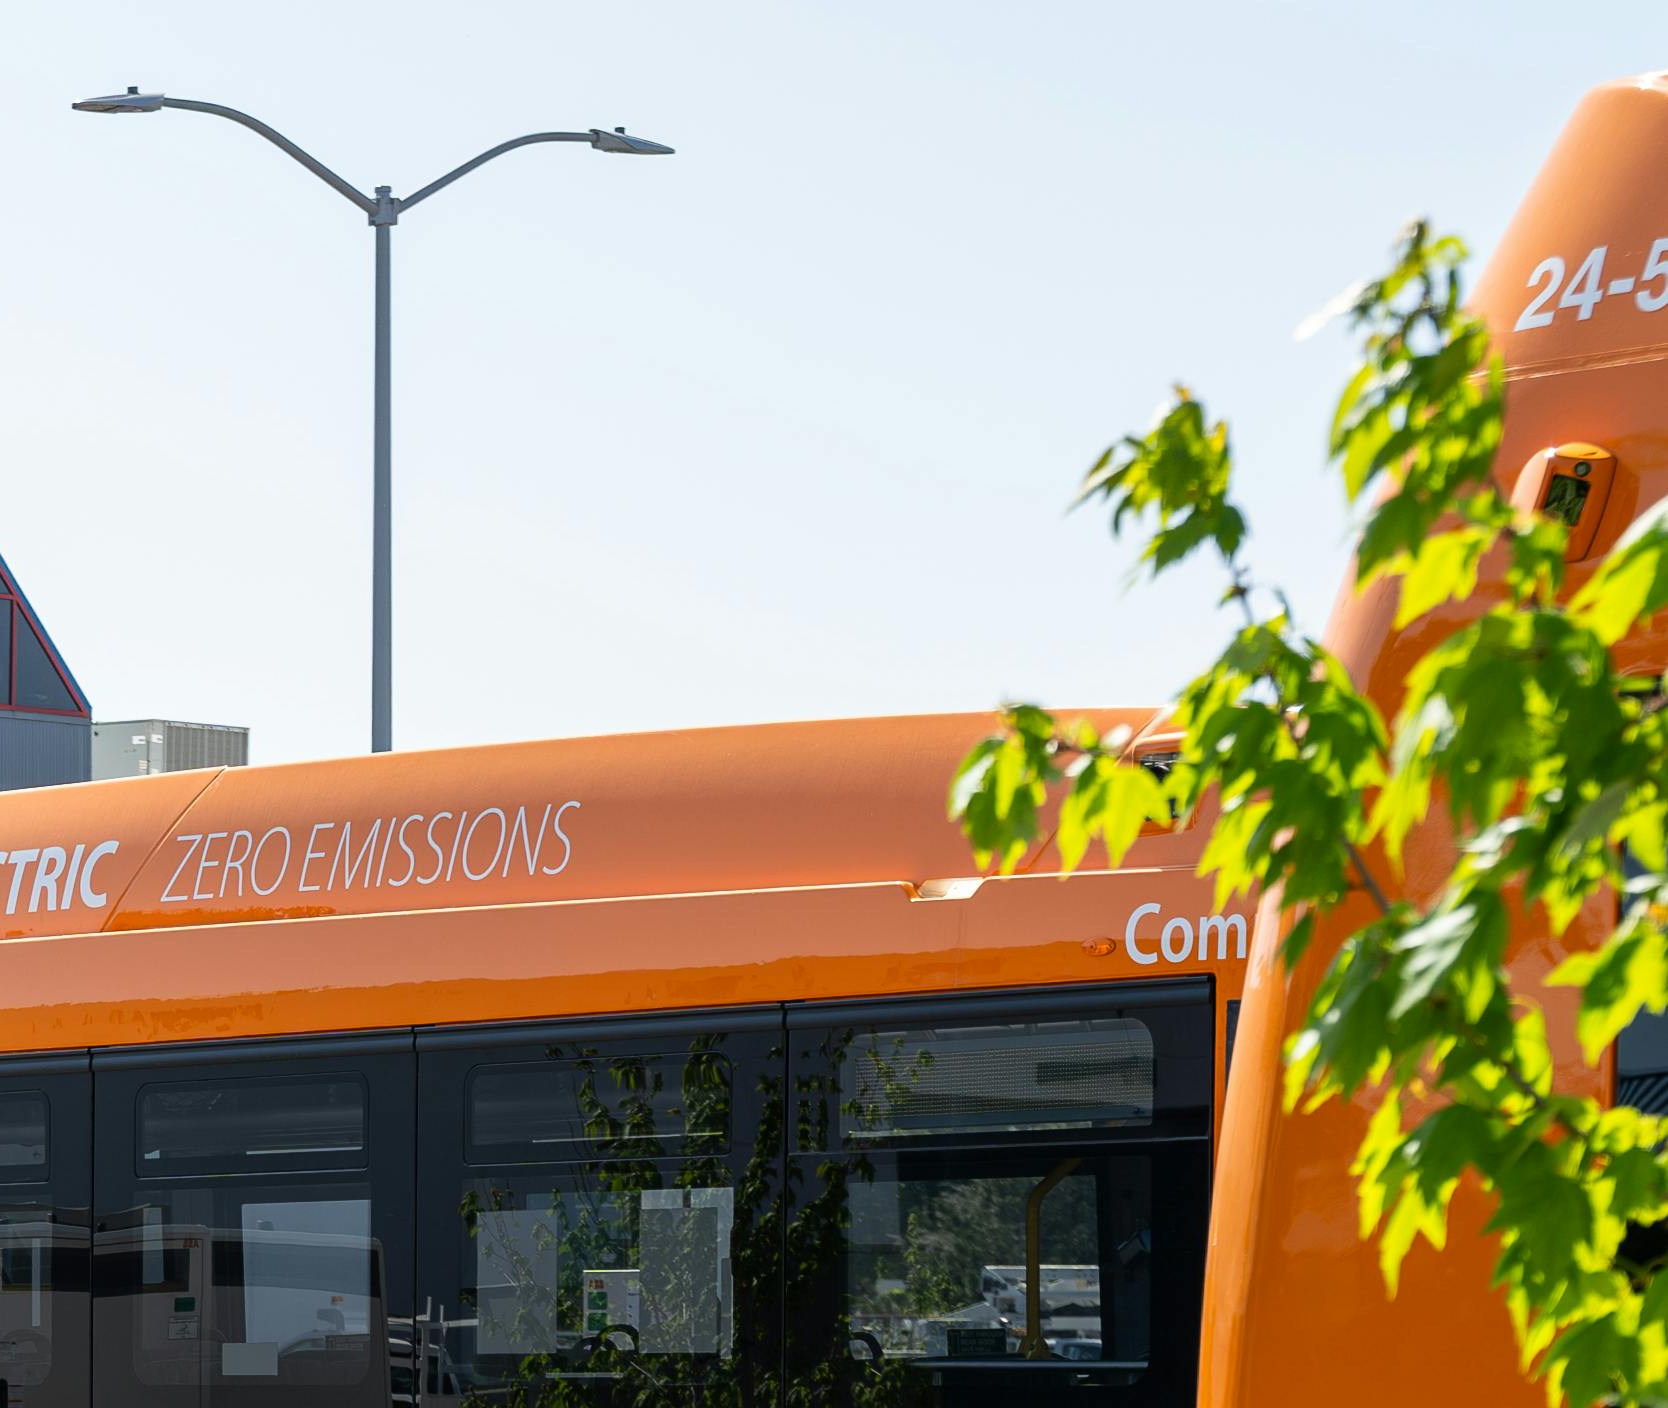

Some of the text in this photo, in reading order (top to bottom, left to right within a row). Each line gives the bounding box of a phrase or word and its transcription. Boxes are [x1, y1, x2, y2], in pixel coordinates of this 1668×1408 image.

[160, 825, 291, 903] ZERO
[298, 800, 581, 893] EMISSIONS
[1125, 902, 1248, 965] Com
